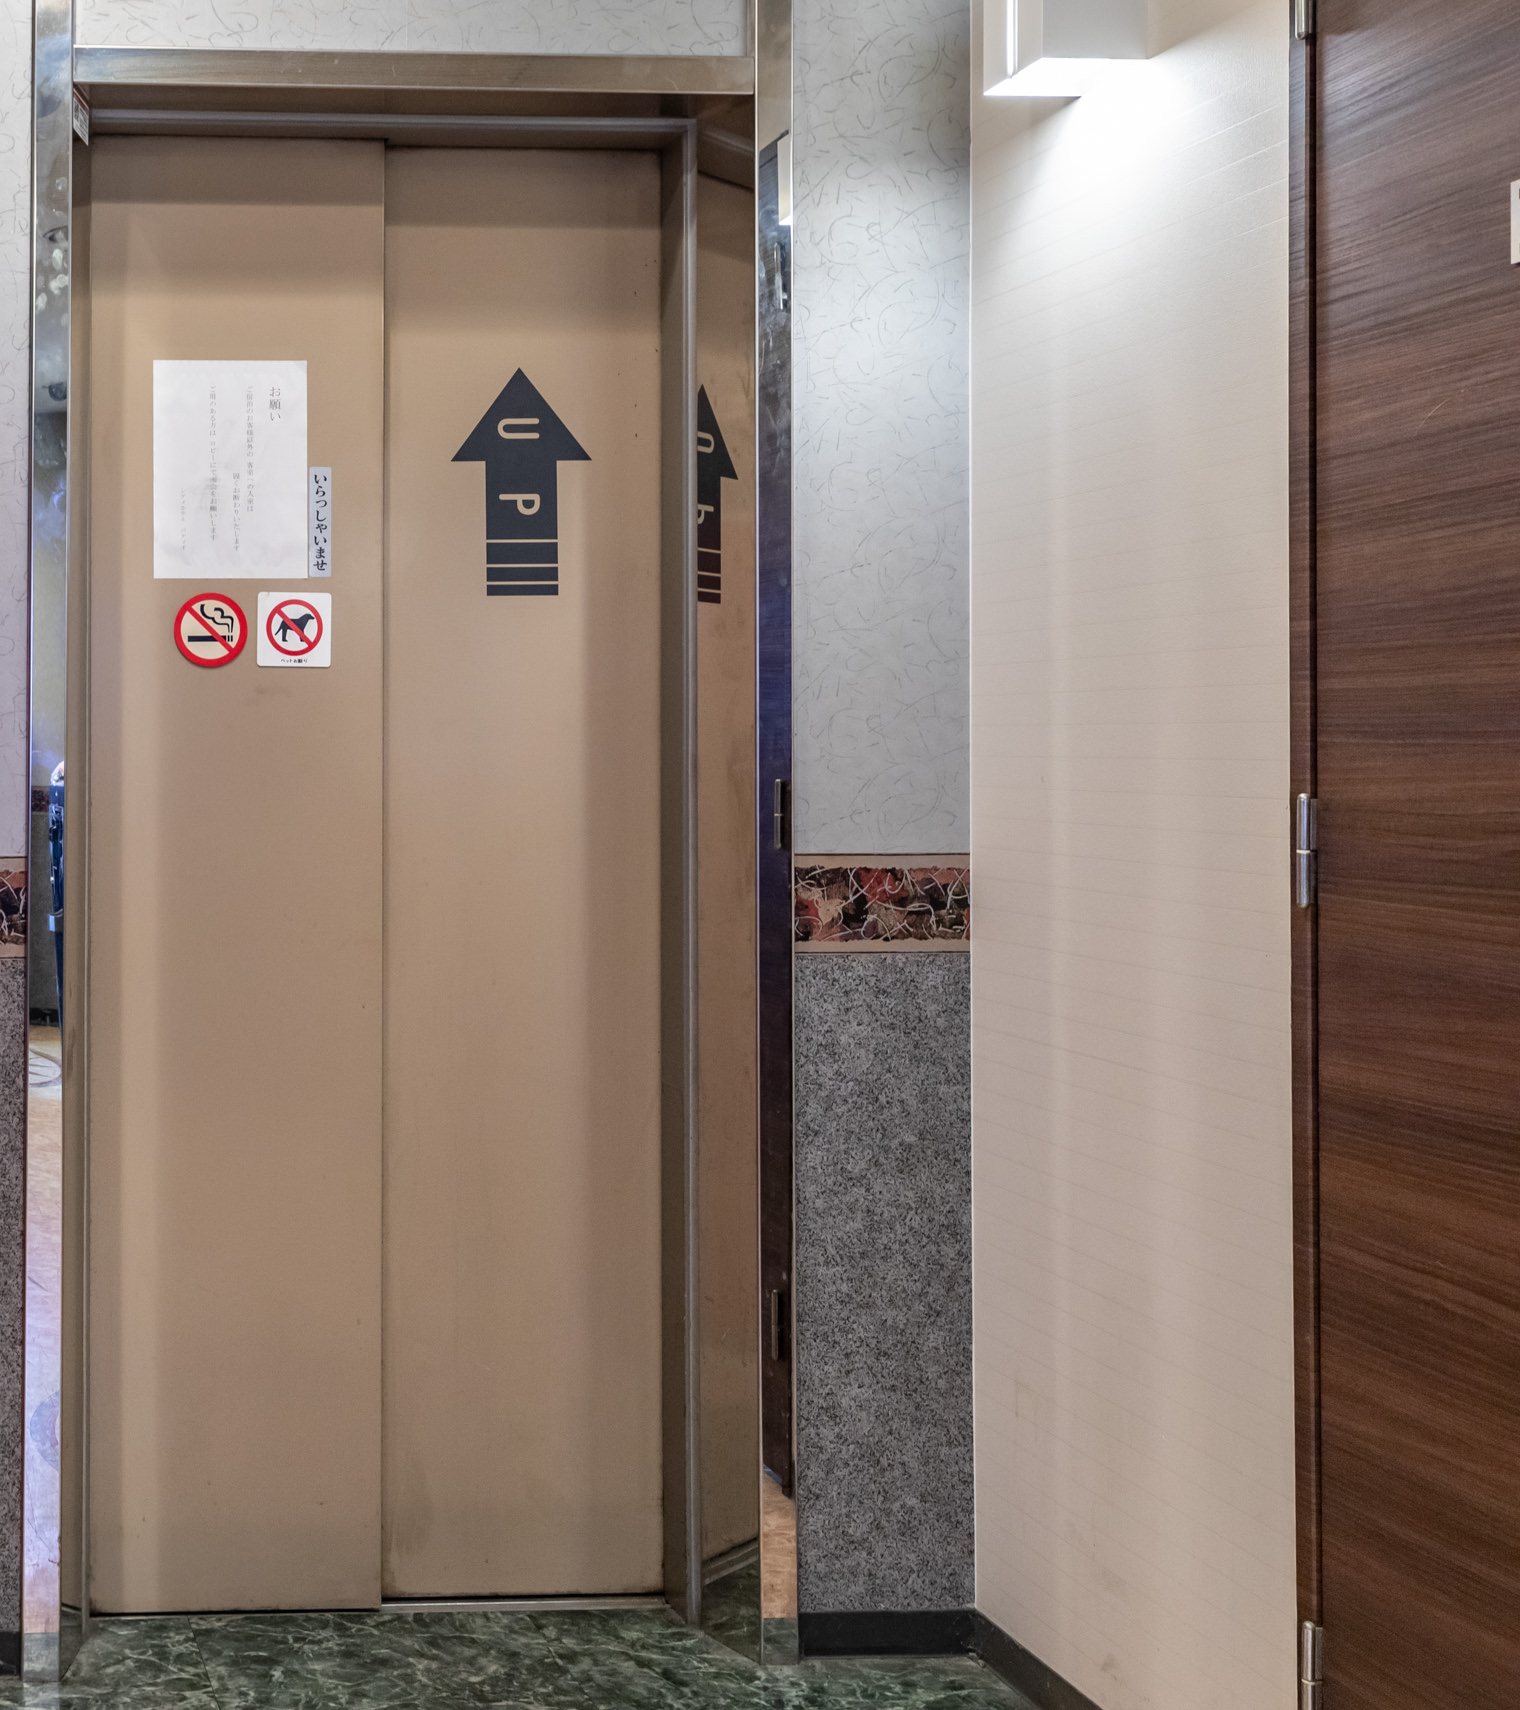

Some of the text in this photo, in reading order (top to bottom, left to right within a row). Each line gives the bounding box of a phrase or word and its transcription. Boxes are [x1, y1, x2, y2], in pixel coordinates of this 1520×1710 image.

[269, 386, 281, 422] お願い
[313, 473, 328, 571] いらっしゃいませ
